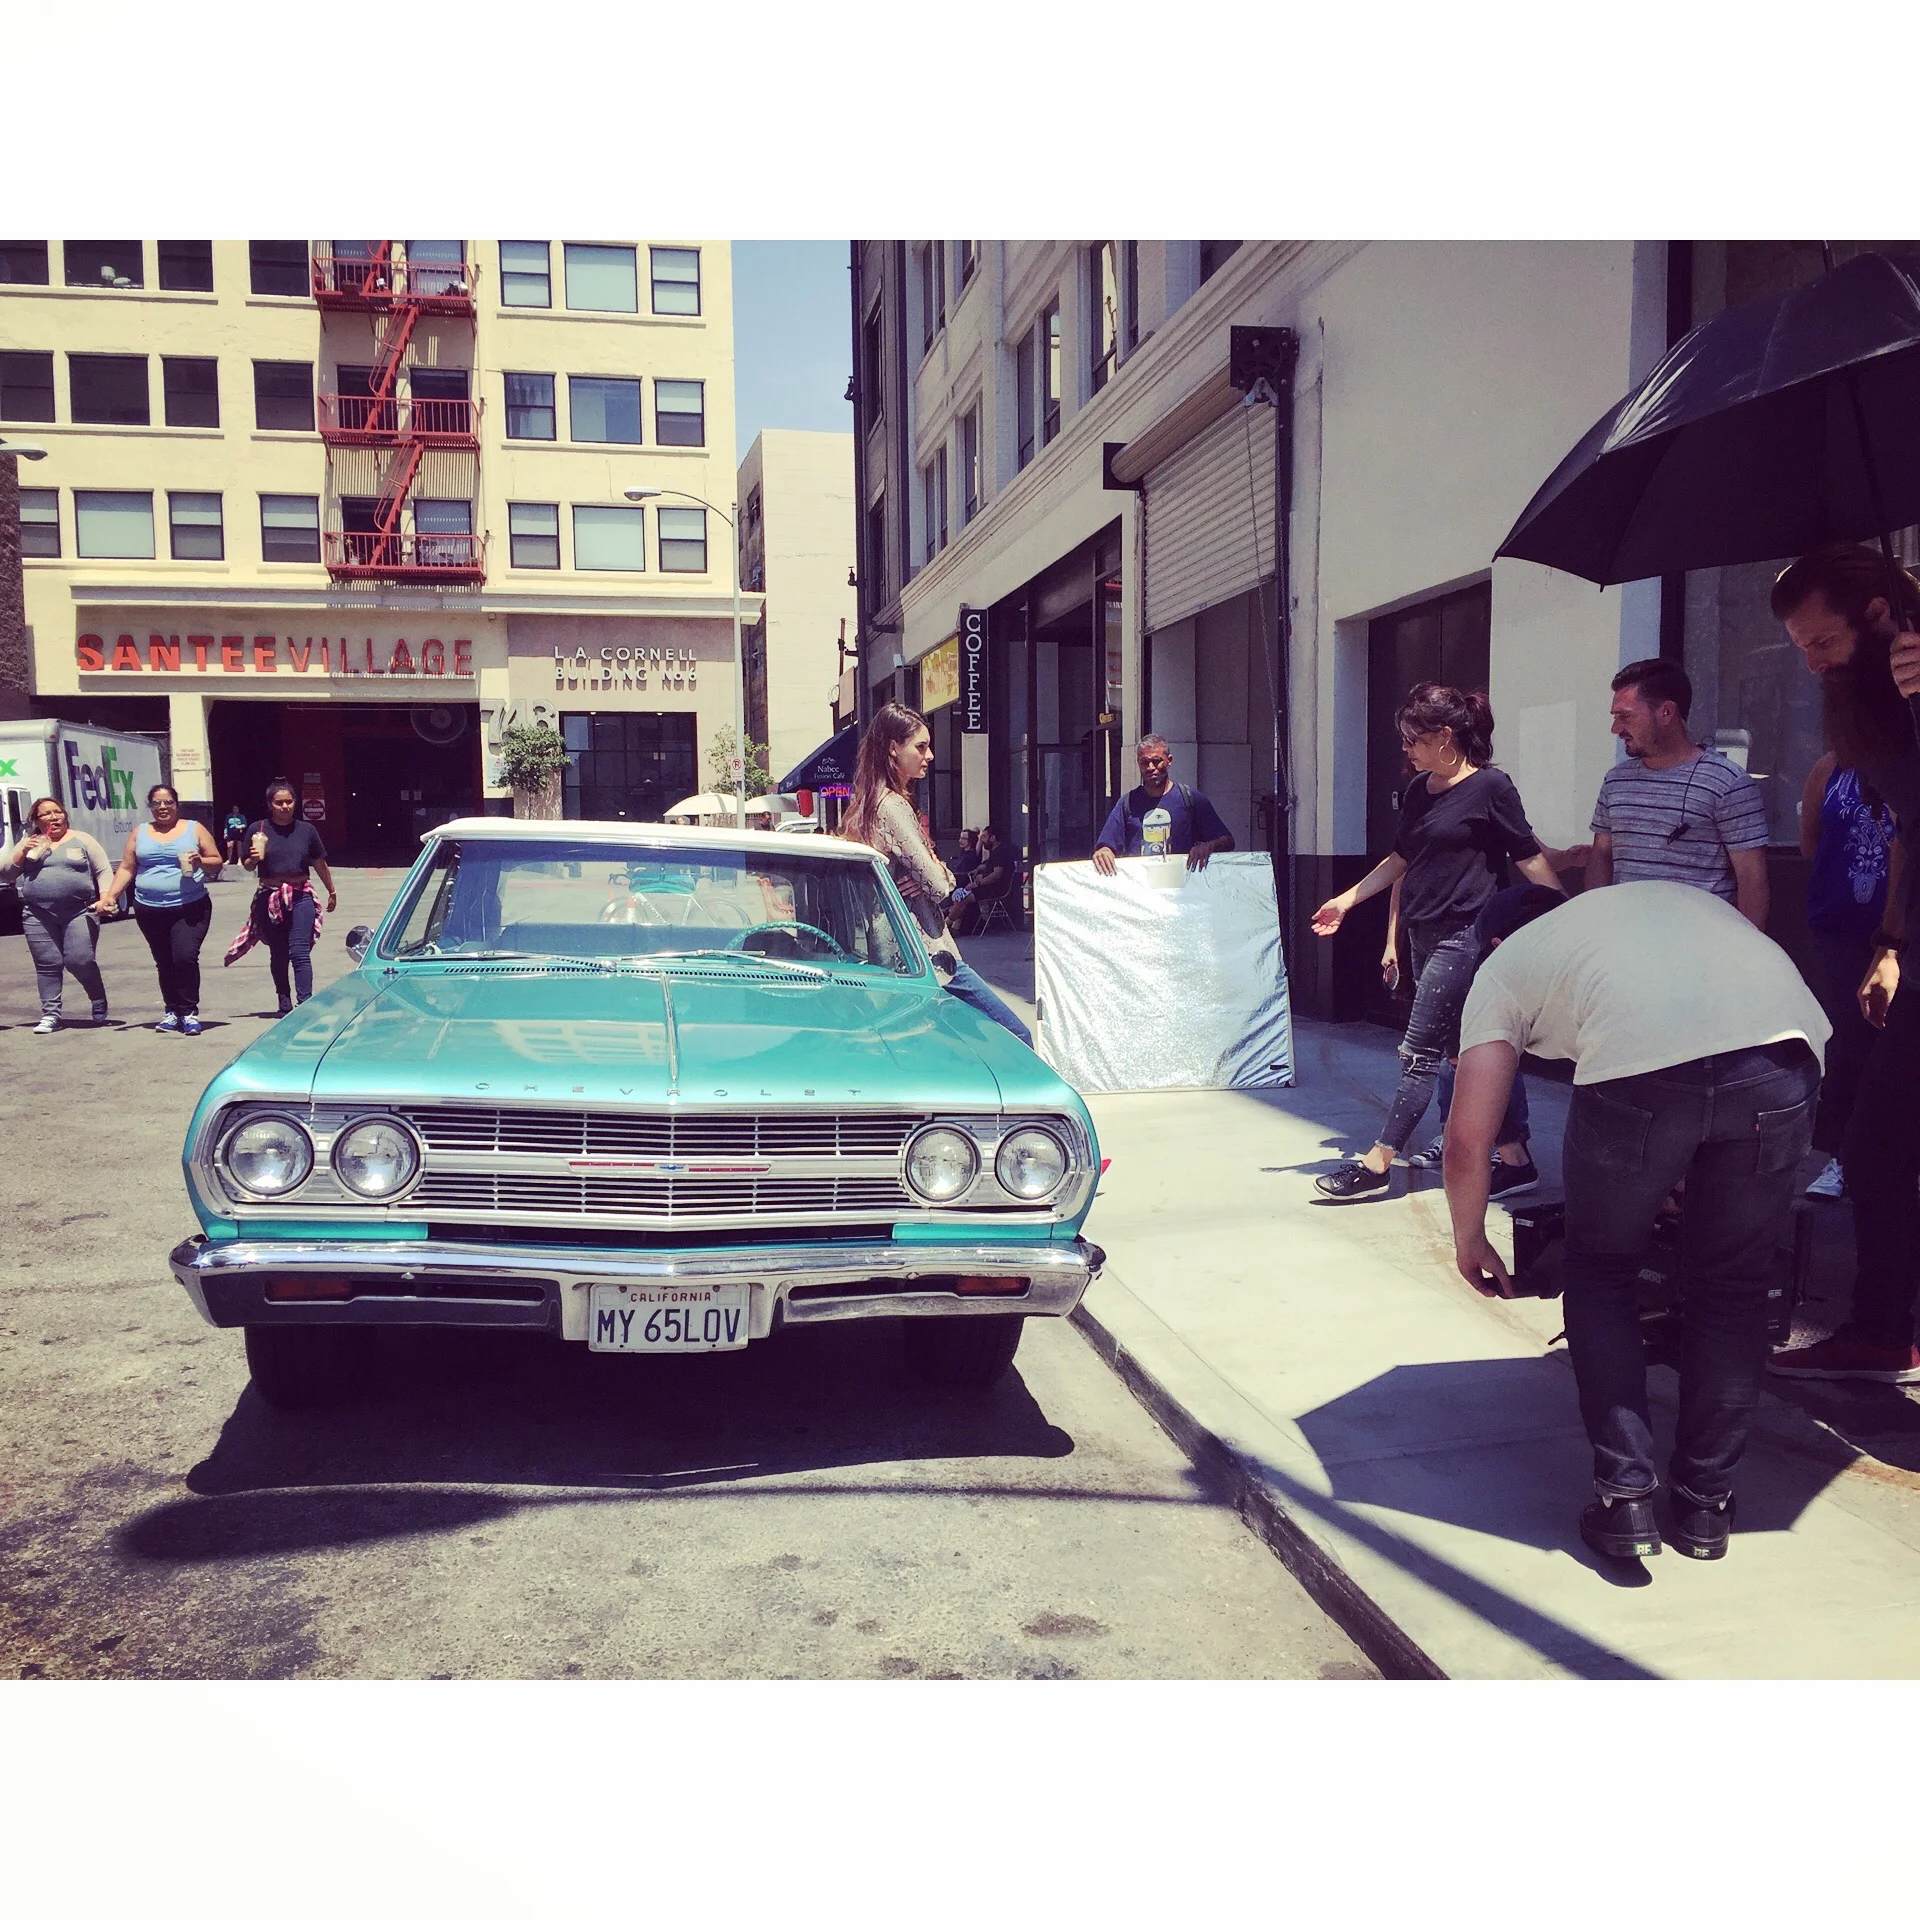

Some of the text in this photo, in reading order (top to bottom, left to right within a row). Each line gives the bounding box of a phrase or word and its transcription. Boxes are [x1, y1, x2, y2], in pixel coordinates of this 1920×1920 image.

[77, 634, 473, 676] SANTEE VILLAGE
[600, 647, 697, 661] CORNELL
[556, 667, 647, 681] BUILDING
[966, 614, 982, 730] COFFEE
[64, 740, 138, 811] FedEx
[820, 786, 851, 797] OPEN
[630, 1291, 712, 1303] CALIFORNIA
[596, 1308, 741, 1343] MY 65LOV
